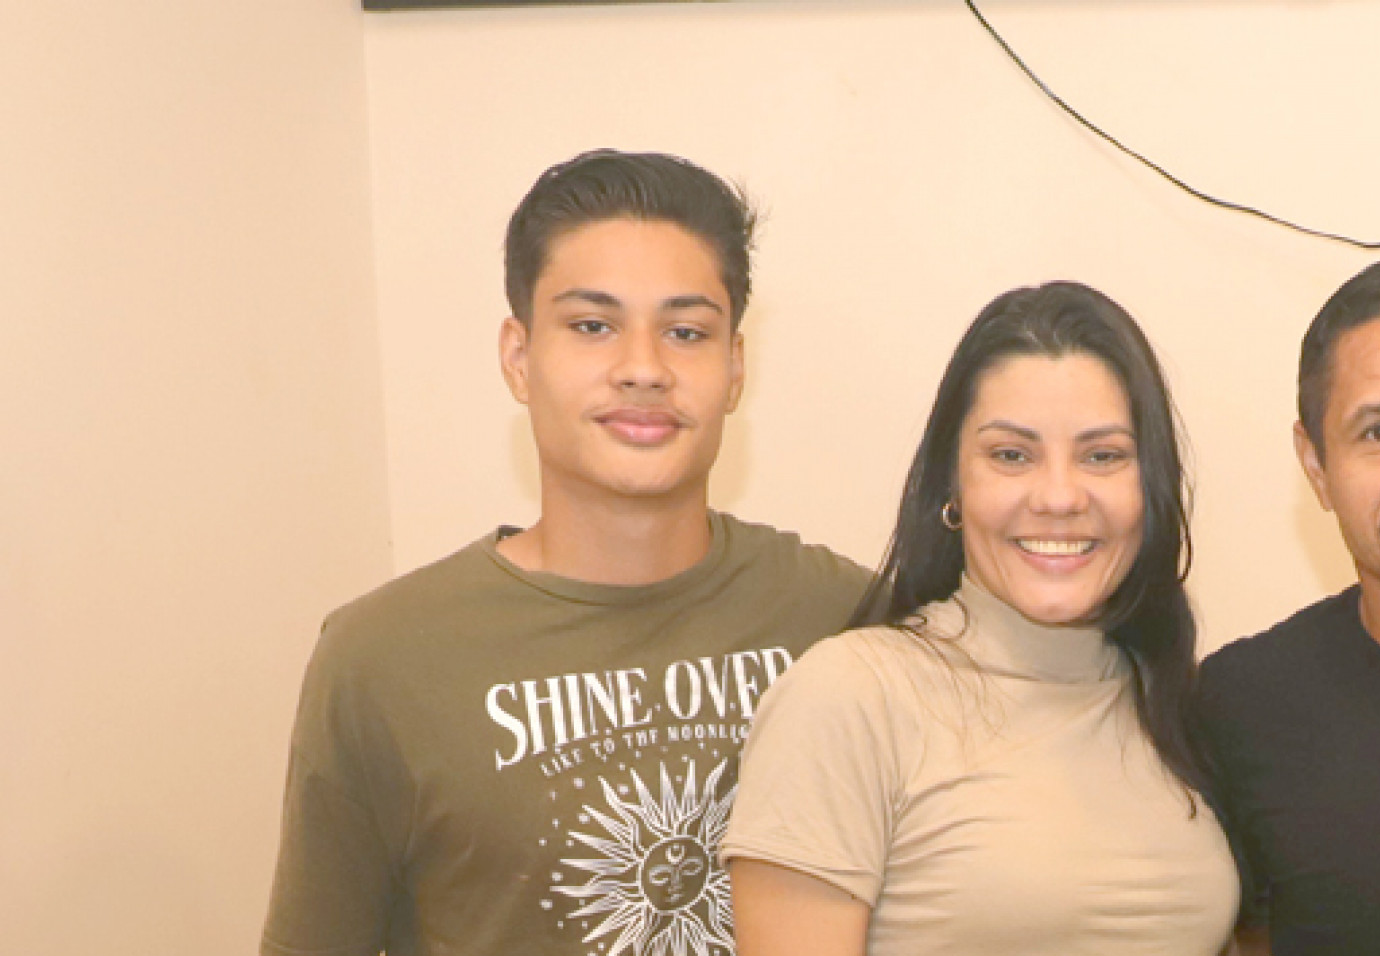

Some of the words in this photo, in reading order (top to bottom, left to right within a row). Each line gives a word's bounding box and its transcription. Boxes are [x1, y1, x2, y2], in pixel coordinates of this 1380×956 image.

[484, 667, 652, 771] SHINE
[540, 748, 583, 777] LIKE
[590, 736, 616, 758] TO
[622, 727, 659, 750] THE
